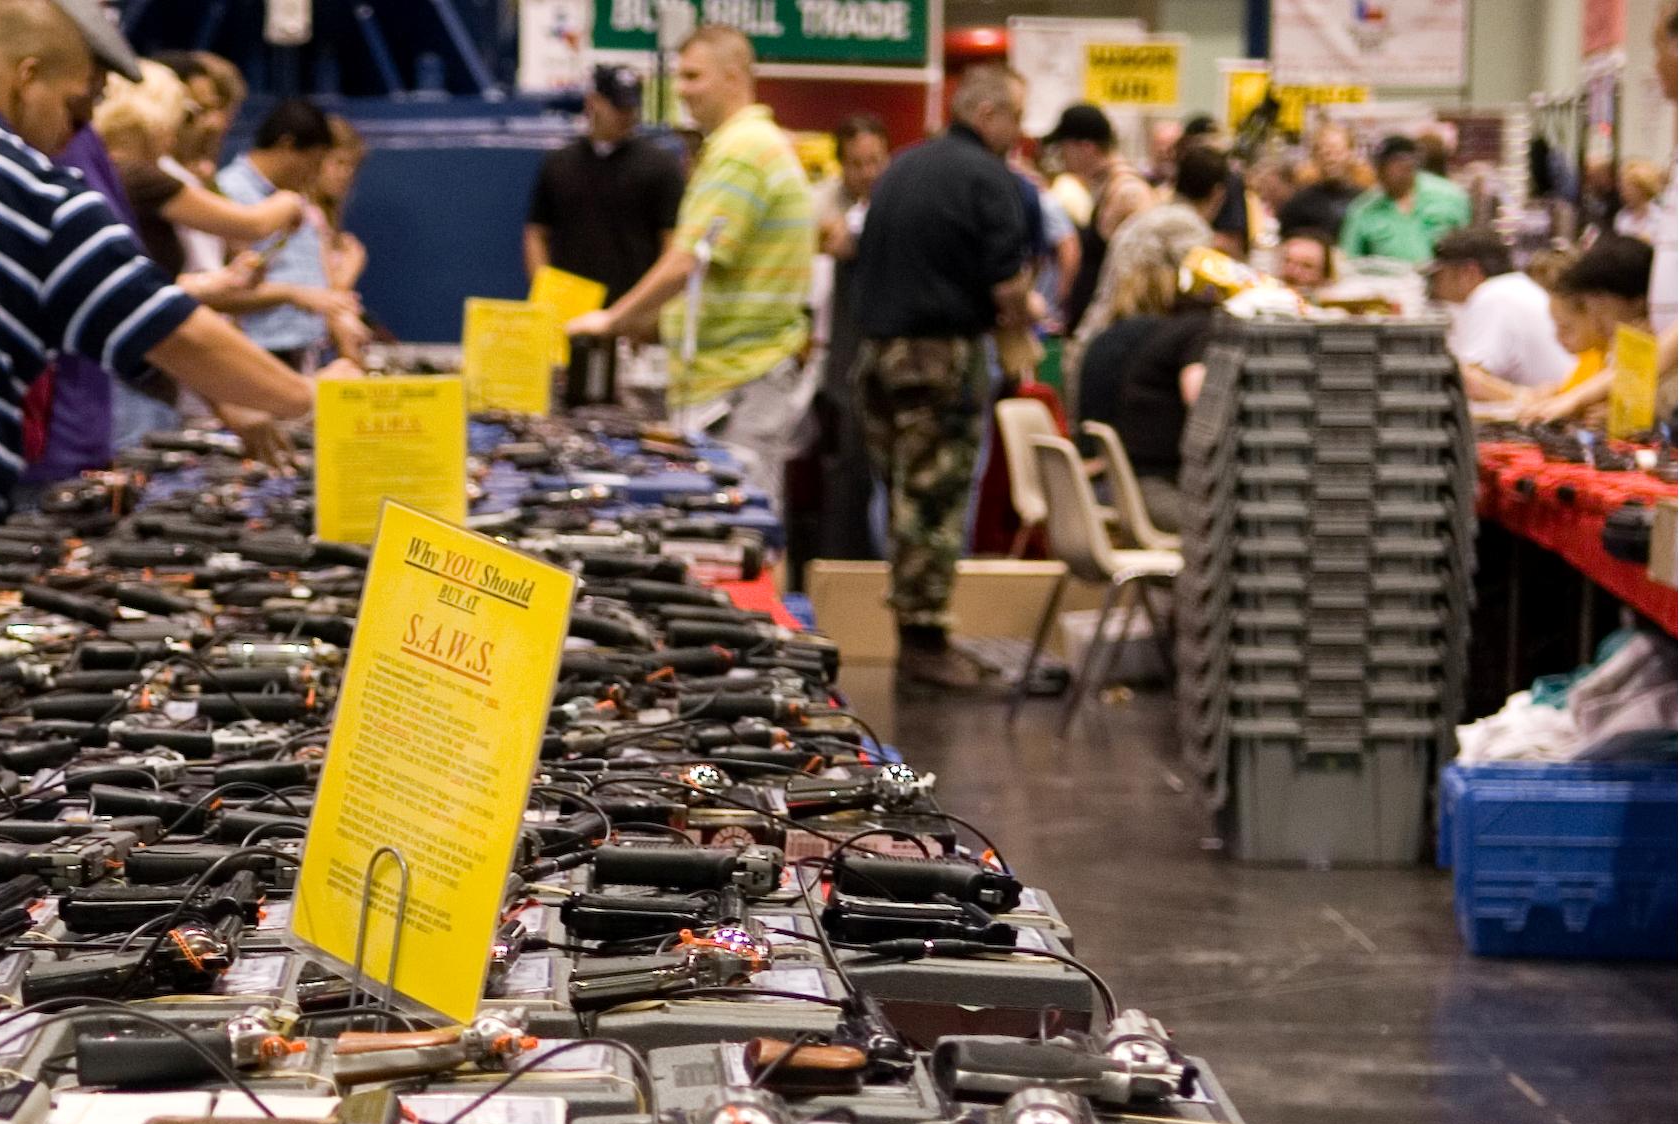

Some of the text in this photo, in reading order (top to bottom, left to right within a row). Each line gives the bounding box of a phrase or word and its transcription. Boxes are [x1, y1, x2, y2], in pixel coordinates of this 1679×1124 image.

[406, 537, 536, 603] Why YOU Should
[438, 583, 465, 604] BUY
[402, 613, 495, 676] S.A.W.S.
